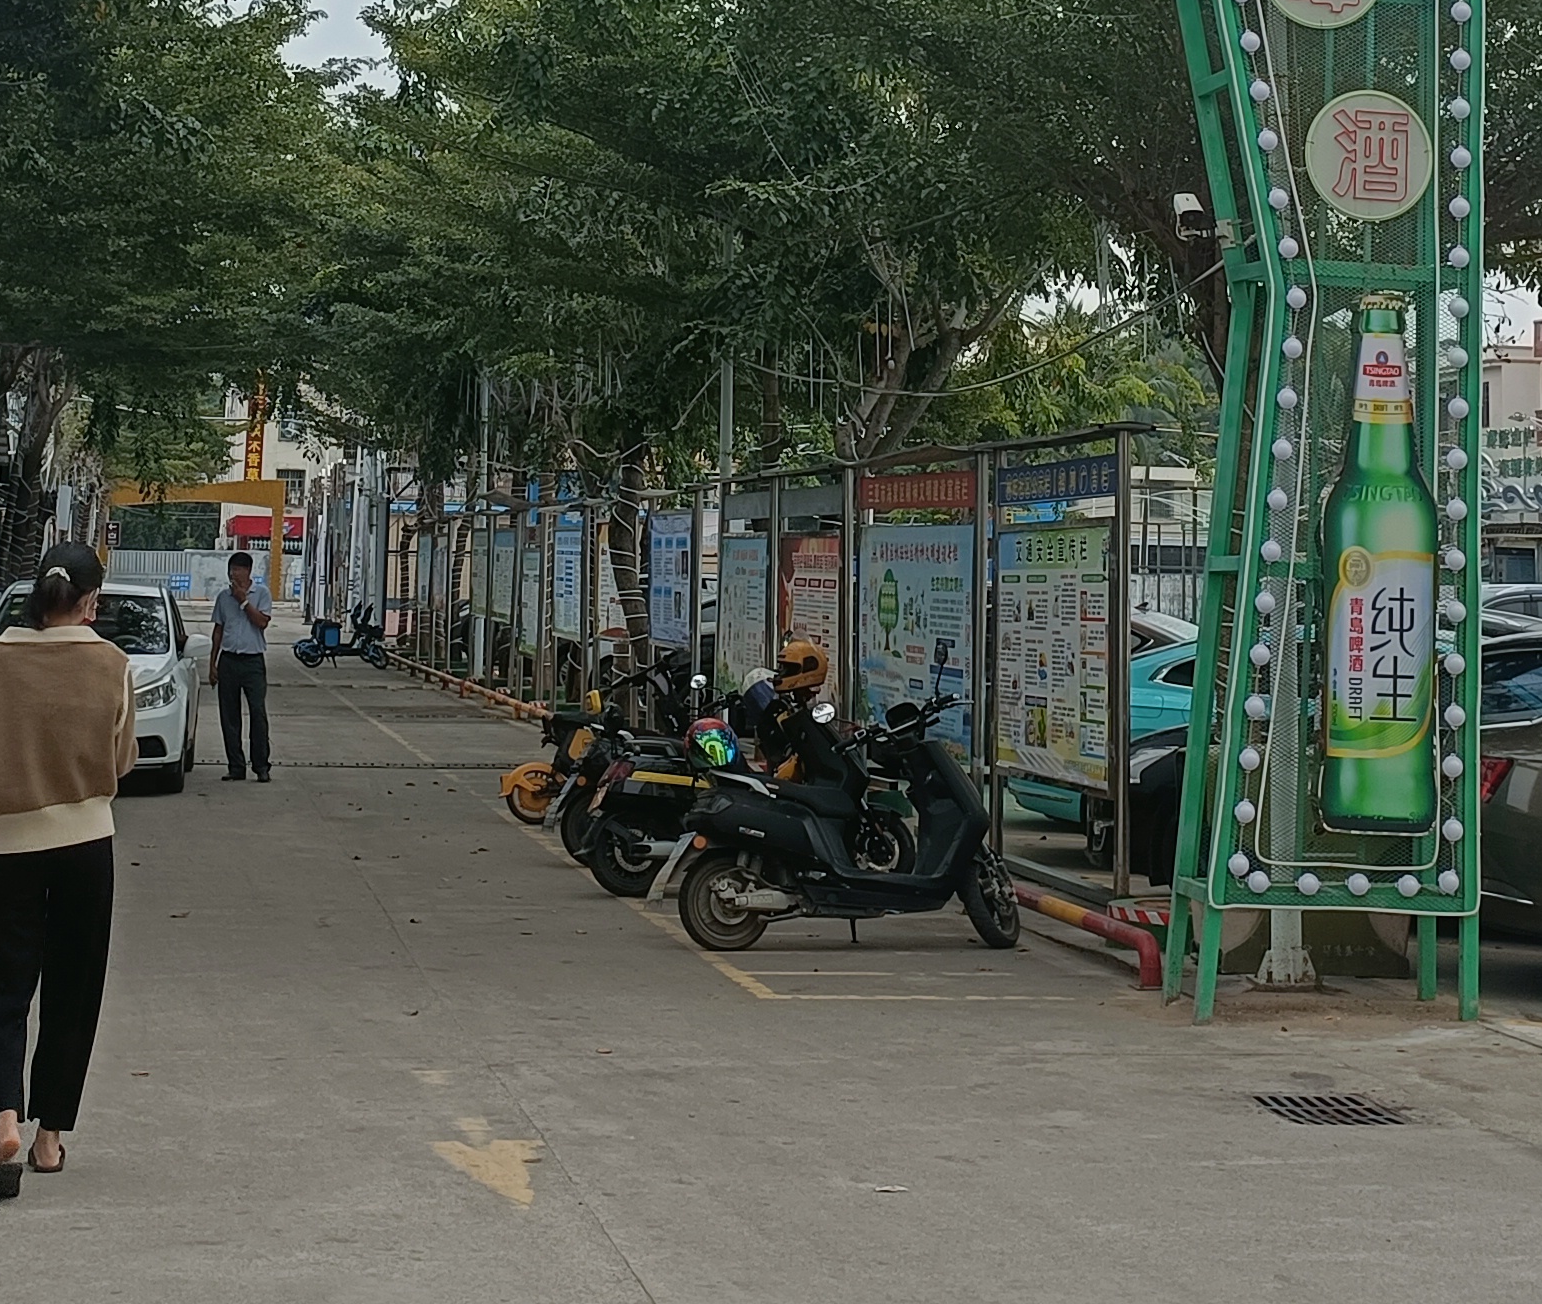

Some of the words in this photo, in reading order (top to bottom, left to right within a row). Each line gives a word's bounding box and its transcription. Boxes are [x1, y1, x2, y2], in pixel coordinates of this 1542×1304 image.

[1365, 367, 1400, 376] TSINGTAO
[1016, 533, 1088, 564] 交通安全宣传栏
[1369, 587, 1417, 722] 纯生
[1348, 677, 1363, 721] DRAFT
